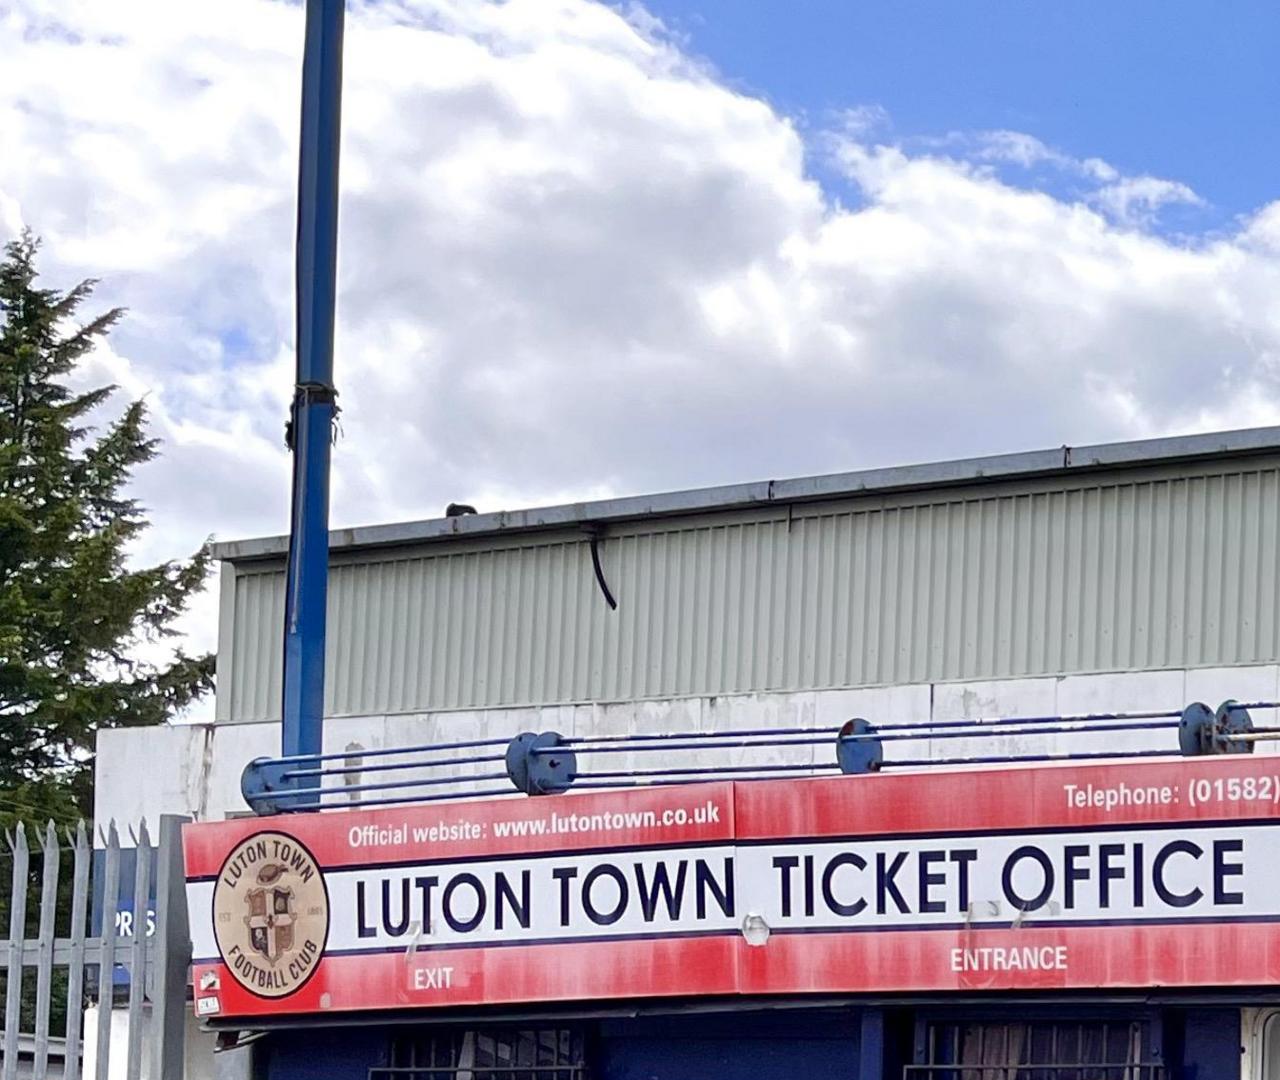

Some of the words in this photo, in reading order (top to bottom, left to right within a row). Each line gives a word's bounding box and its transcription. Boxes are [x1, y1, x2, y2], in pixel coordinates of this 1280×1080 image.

[1064, 783, 1179, 811] Telephone:
[1189, 775, 1280, 807] (01582)
[348, 822, 407, 849] Official
[414, 818, 487, 842] website:
[493, 802, 720, 838] www.lutontown.co.uk
[224, 841, 268, 888] LUTON
[273, 840, 314, 884] TOWN
[356, 869, 531, 939] LUTON
[553, 857, 735, 927] TOWN
[772, 848, 978, 918] TICKET
[1002, 839, 1245, 911] OFFICE
[228, 945, 288, 989] FOOTBALL
[289, 939, 318, 981] CLUB
[414, 967, 453, 990] EXIT
[950, 945, 1067, 971] ENTRANCE
